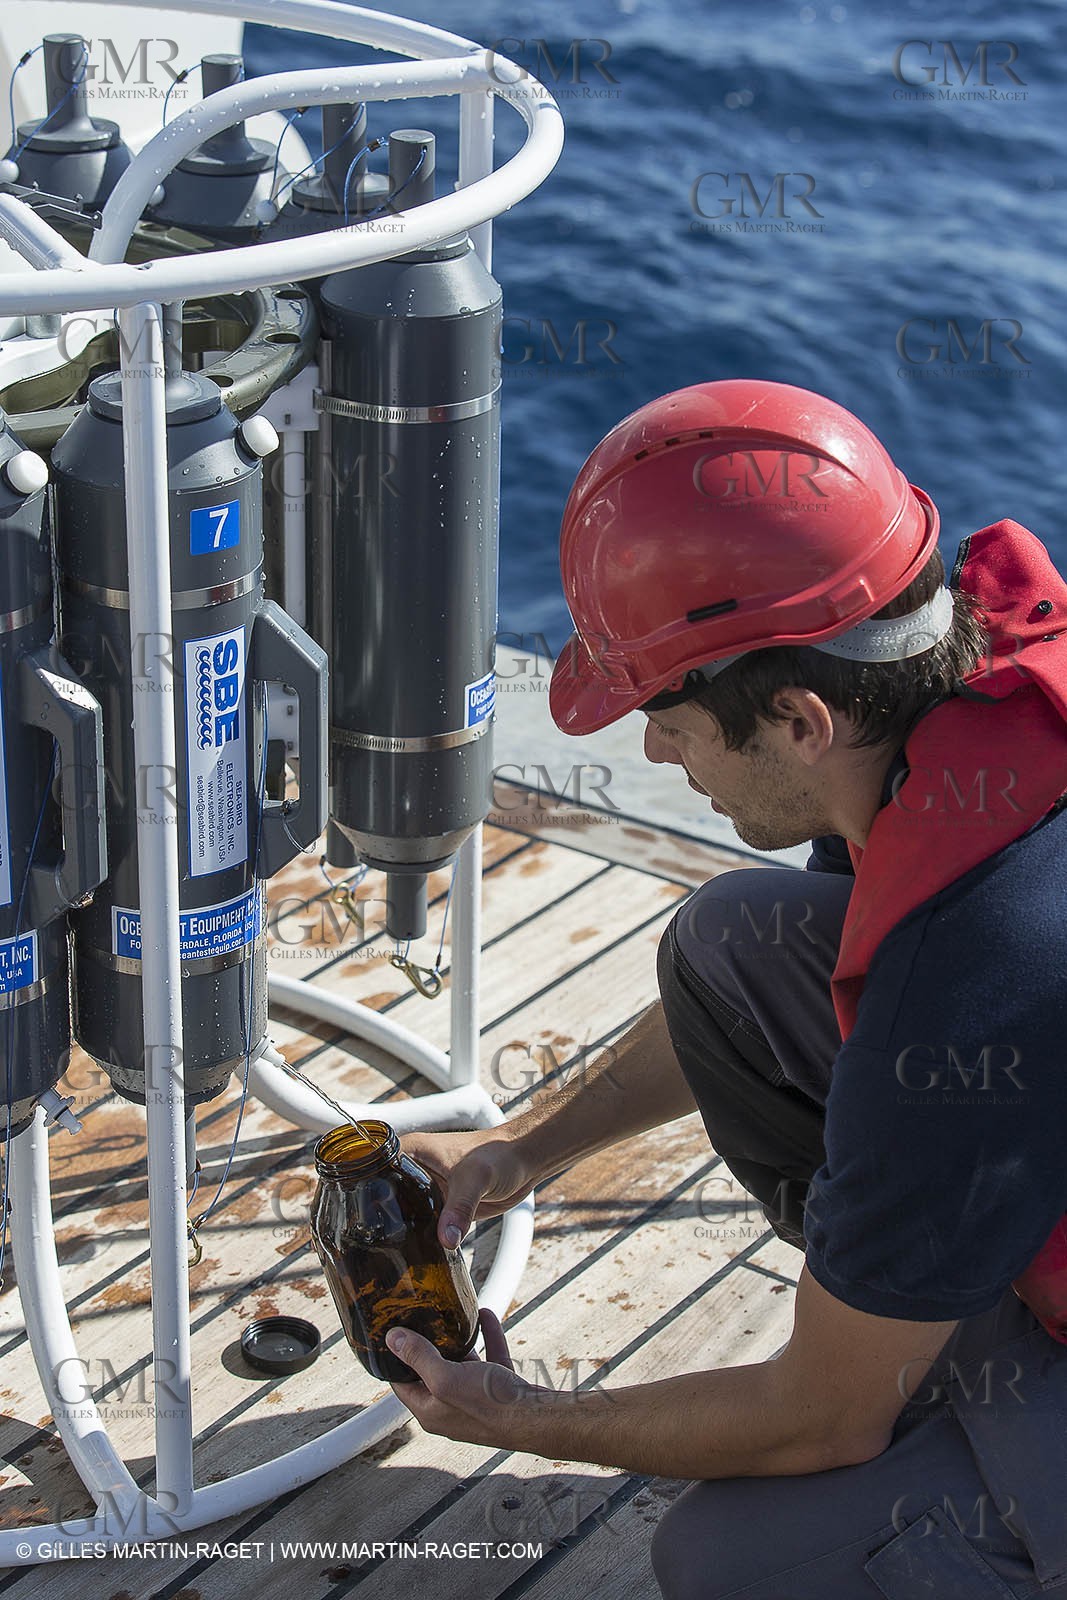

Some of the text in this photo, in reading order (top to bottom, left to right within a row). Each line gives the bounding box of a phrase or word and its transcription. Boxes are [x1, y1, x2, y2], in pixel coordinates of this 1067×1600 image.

[209, 507, 229, 548] 7
[213, 638, 240, 748] SBE
[196, 775, 206, 858] seabird@seabird.com
[207, 781, 215, 847] www.seabird.com
[216, 759, 226, 863] Bellevue, Washington, USA
[225, 763, 235, 855] ELECTRONICS, INC.
[235, 780, 243, 826] SEA-BIRD
[120, 916, 141, 936] OCE
[130, 940, 142, 950] FO
